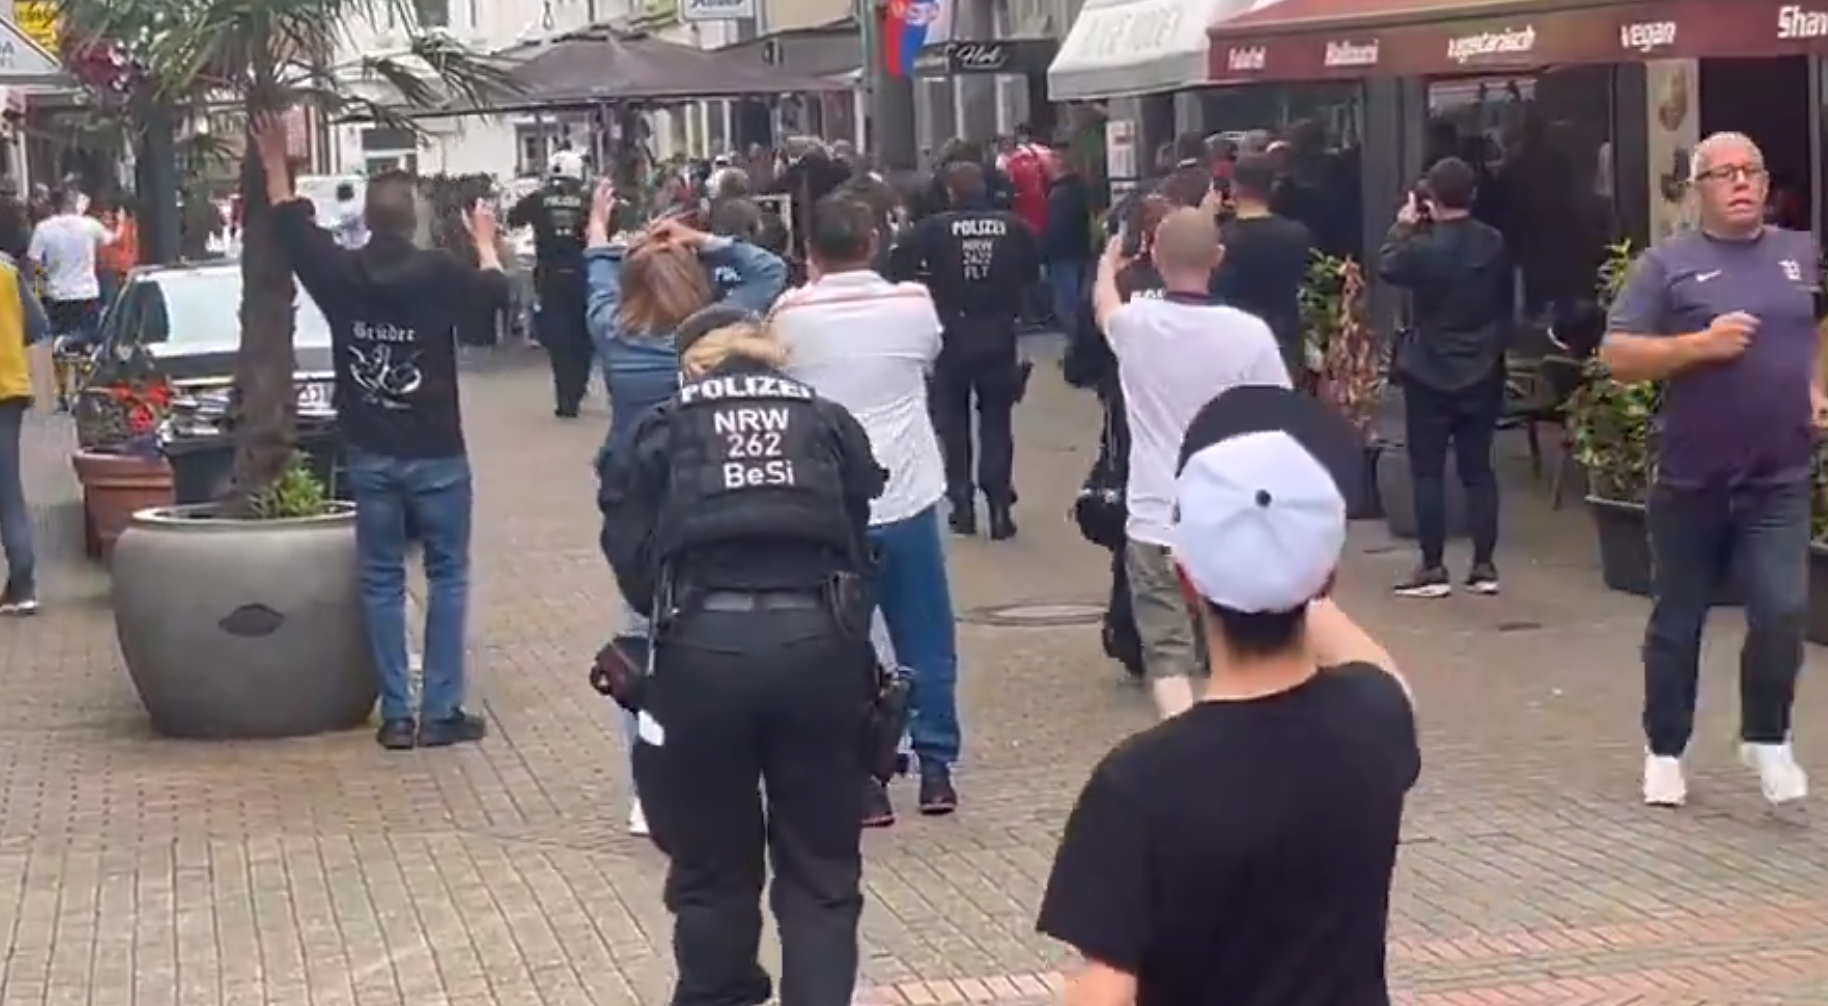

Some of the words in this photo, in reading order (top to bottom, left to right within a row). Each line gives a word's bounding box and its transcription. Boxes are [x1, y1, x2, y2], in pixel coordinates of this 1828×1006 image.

[952, 219, 1006, 236] POLIZEI
[680, 376, 812, 403] POLIZEI
[713, 407, 789, 434] NRW
[727, 431, 782, 458] 262
[723, 460, 795, 489] BeSi
